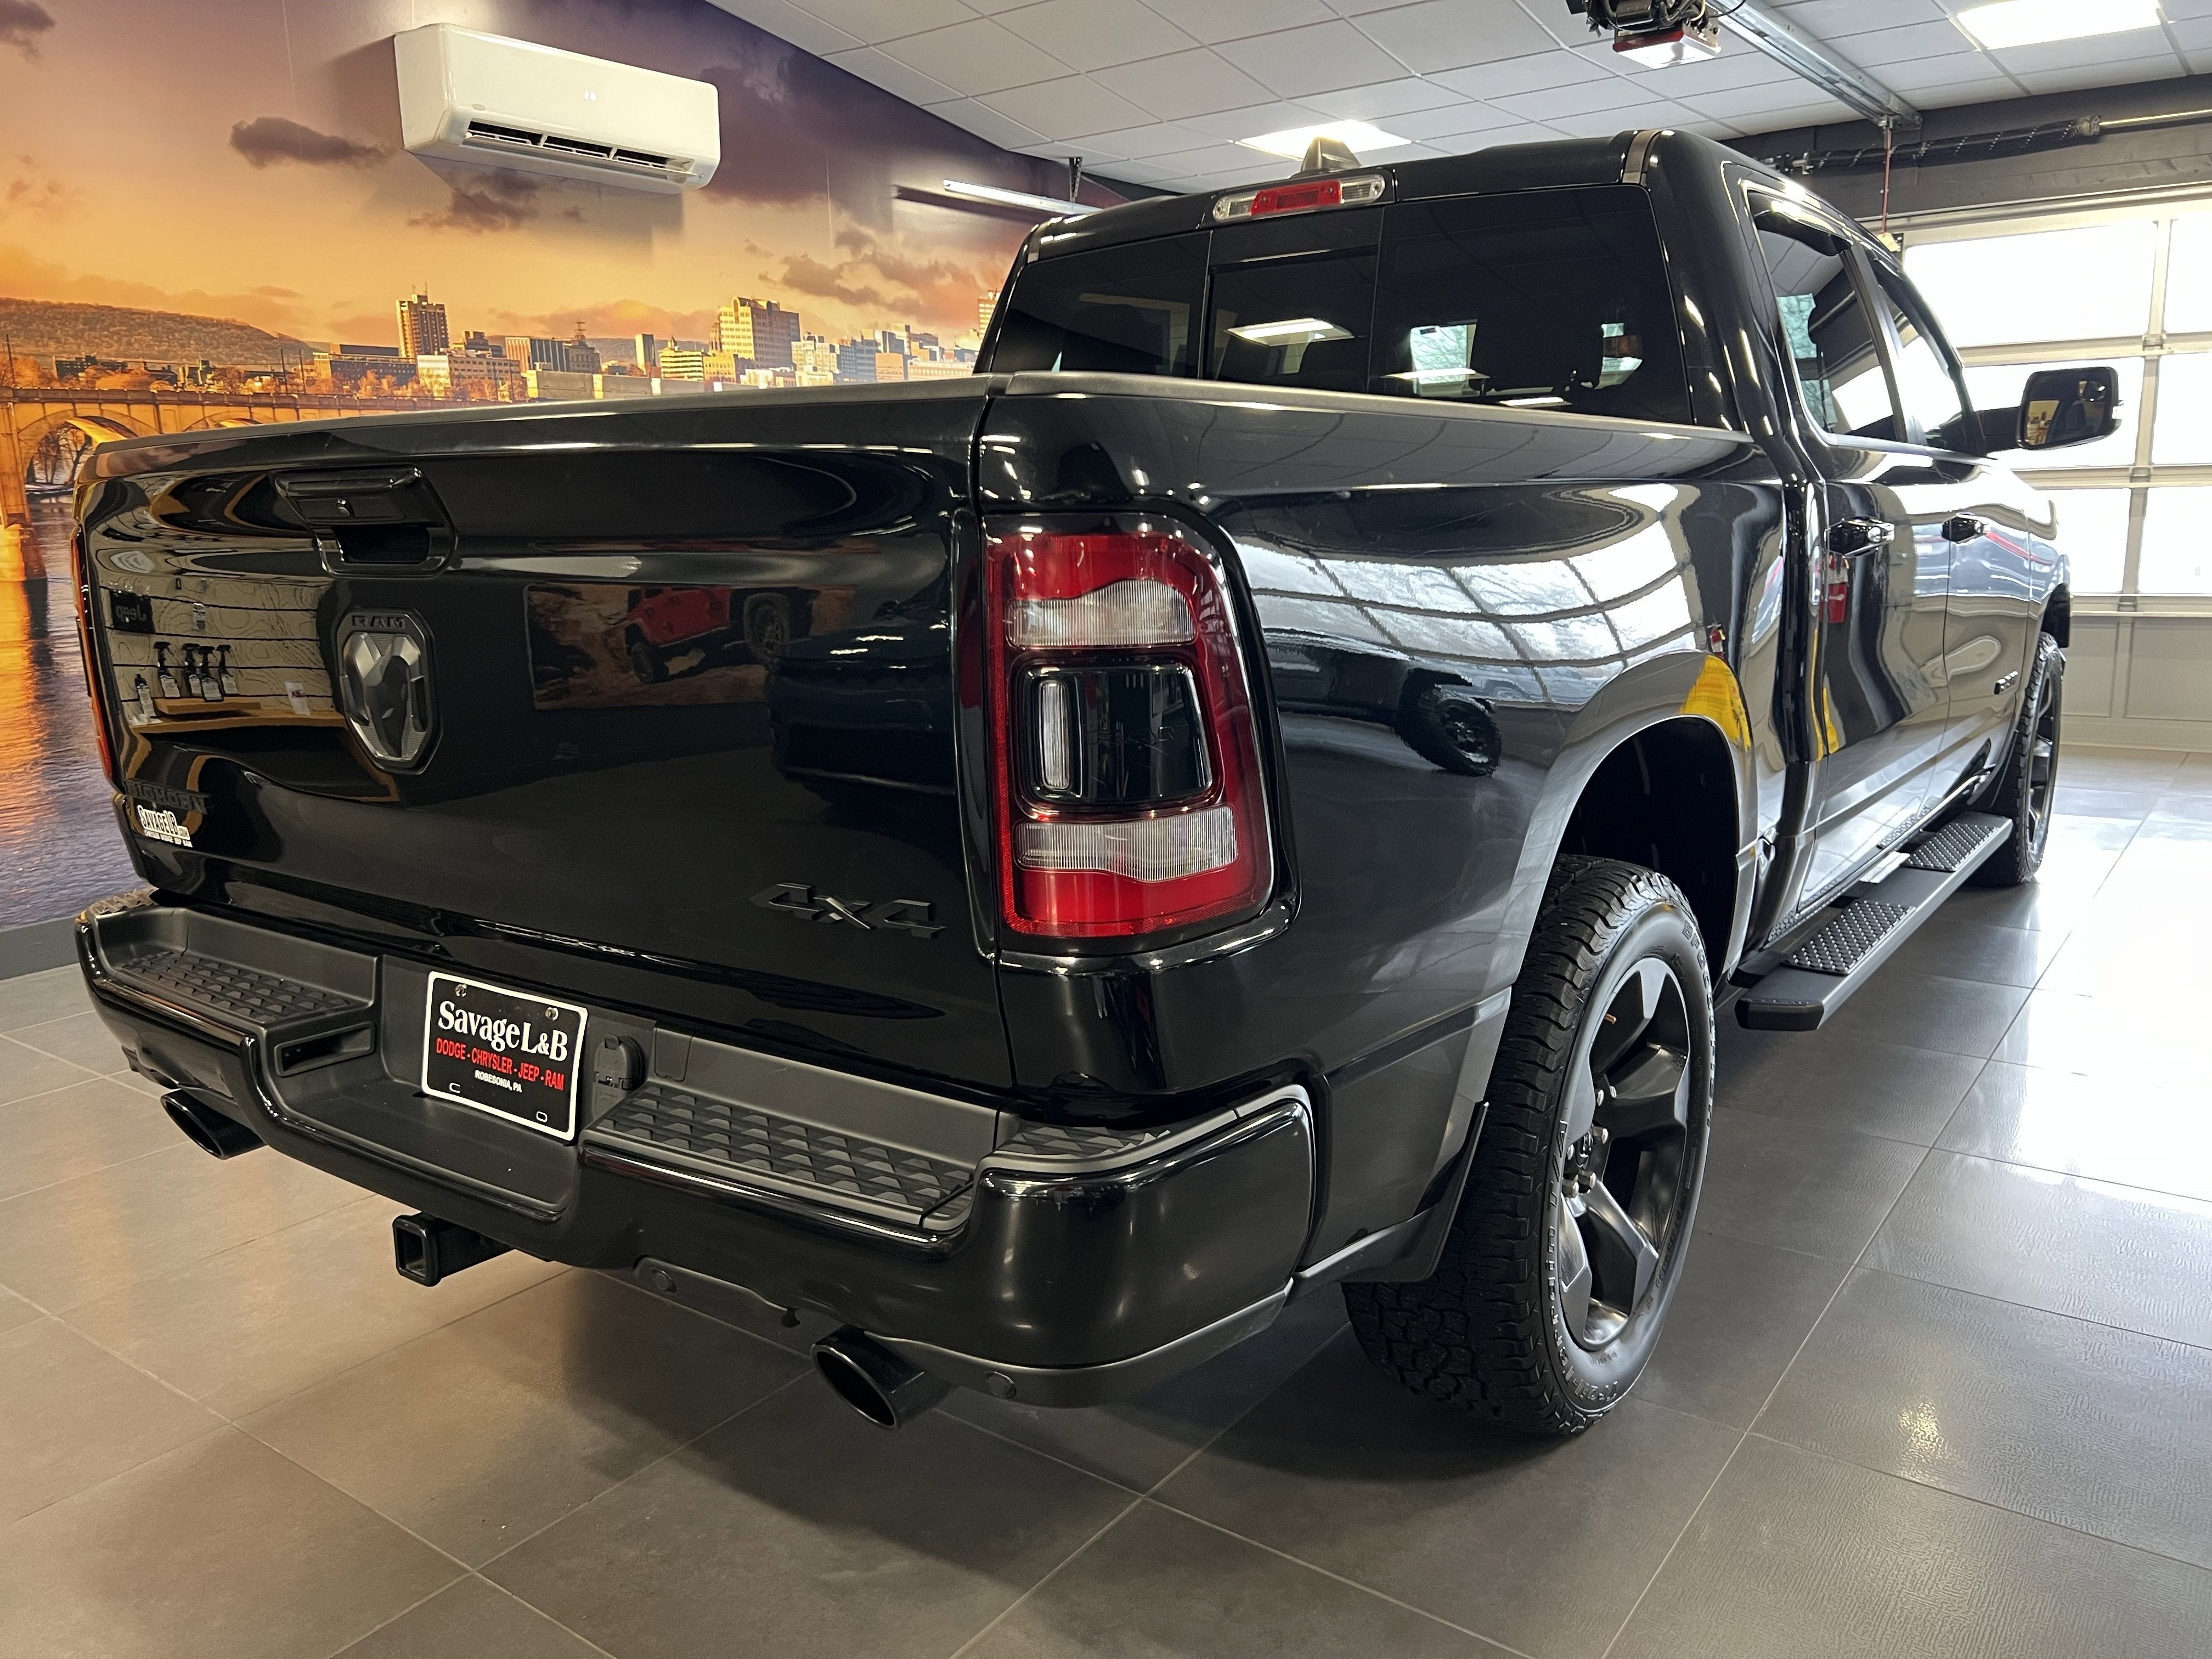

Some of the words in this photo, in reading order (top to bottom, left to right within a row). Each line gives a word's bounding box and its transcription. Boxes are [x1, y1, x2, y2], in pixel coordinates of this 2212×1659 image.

[352, 615, 406, 629] RAM
[436, 1037, 466, 1060] DODGE
[471, 1047, 512, 1075] CHRYSLER
[518, 1062, 540, 1082] JEEP
[545, 1070, 565, 1091] RAM
[512, 1082, 522, 1093] PA
